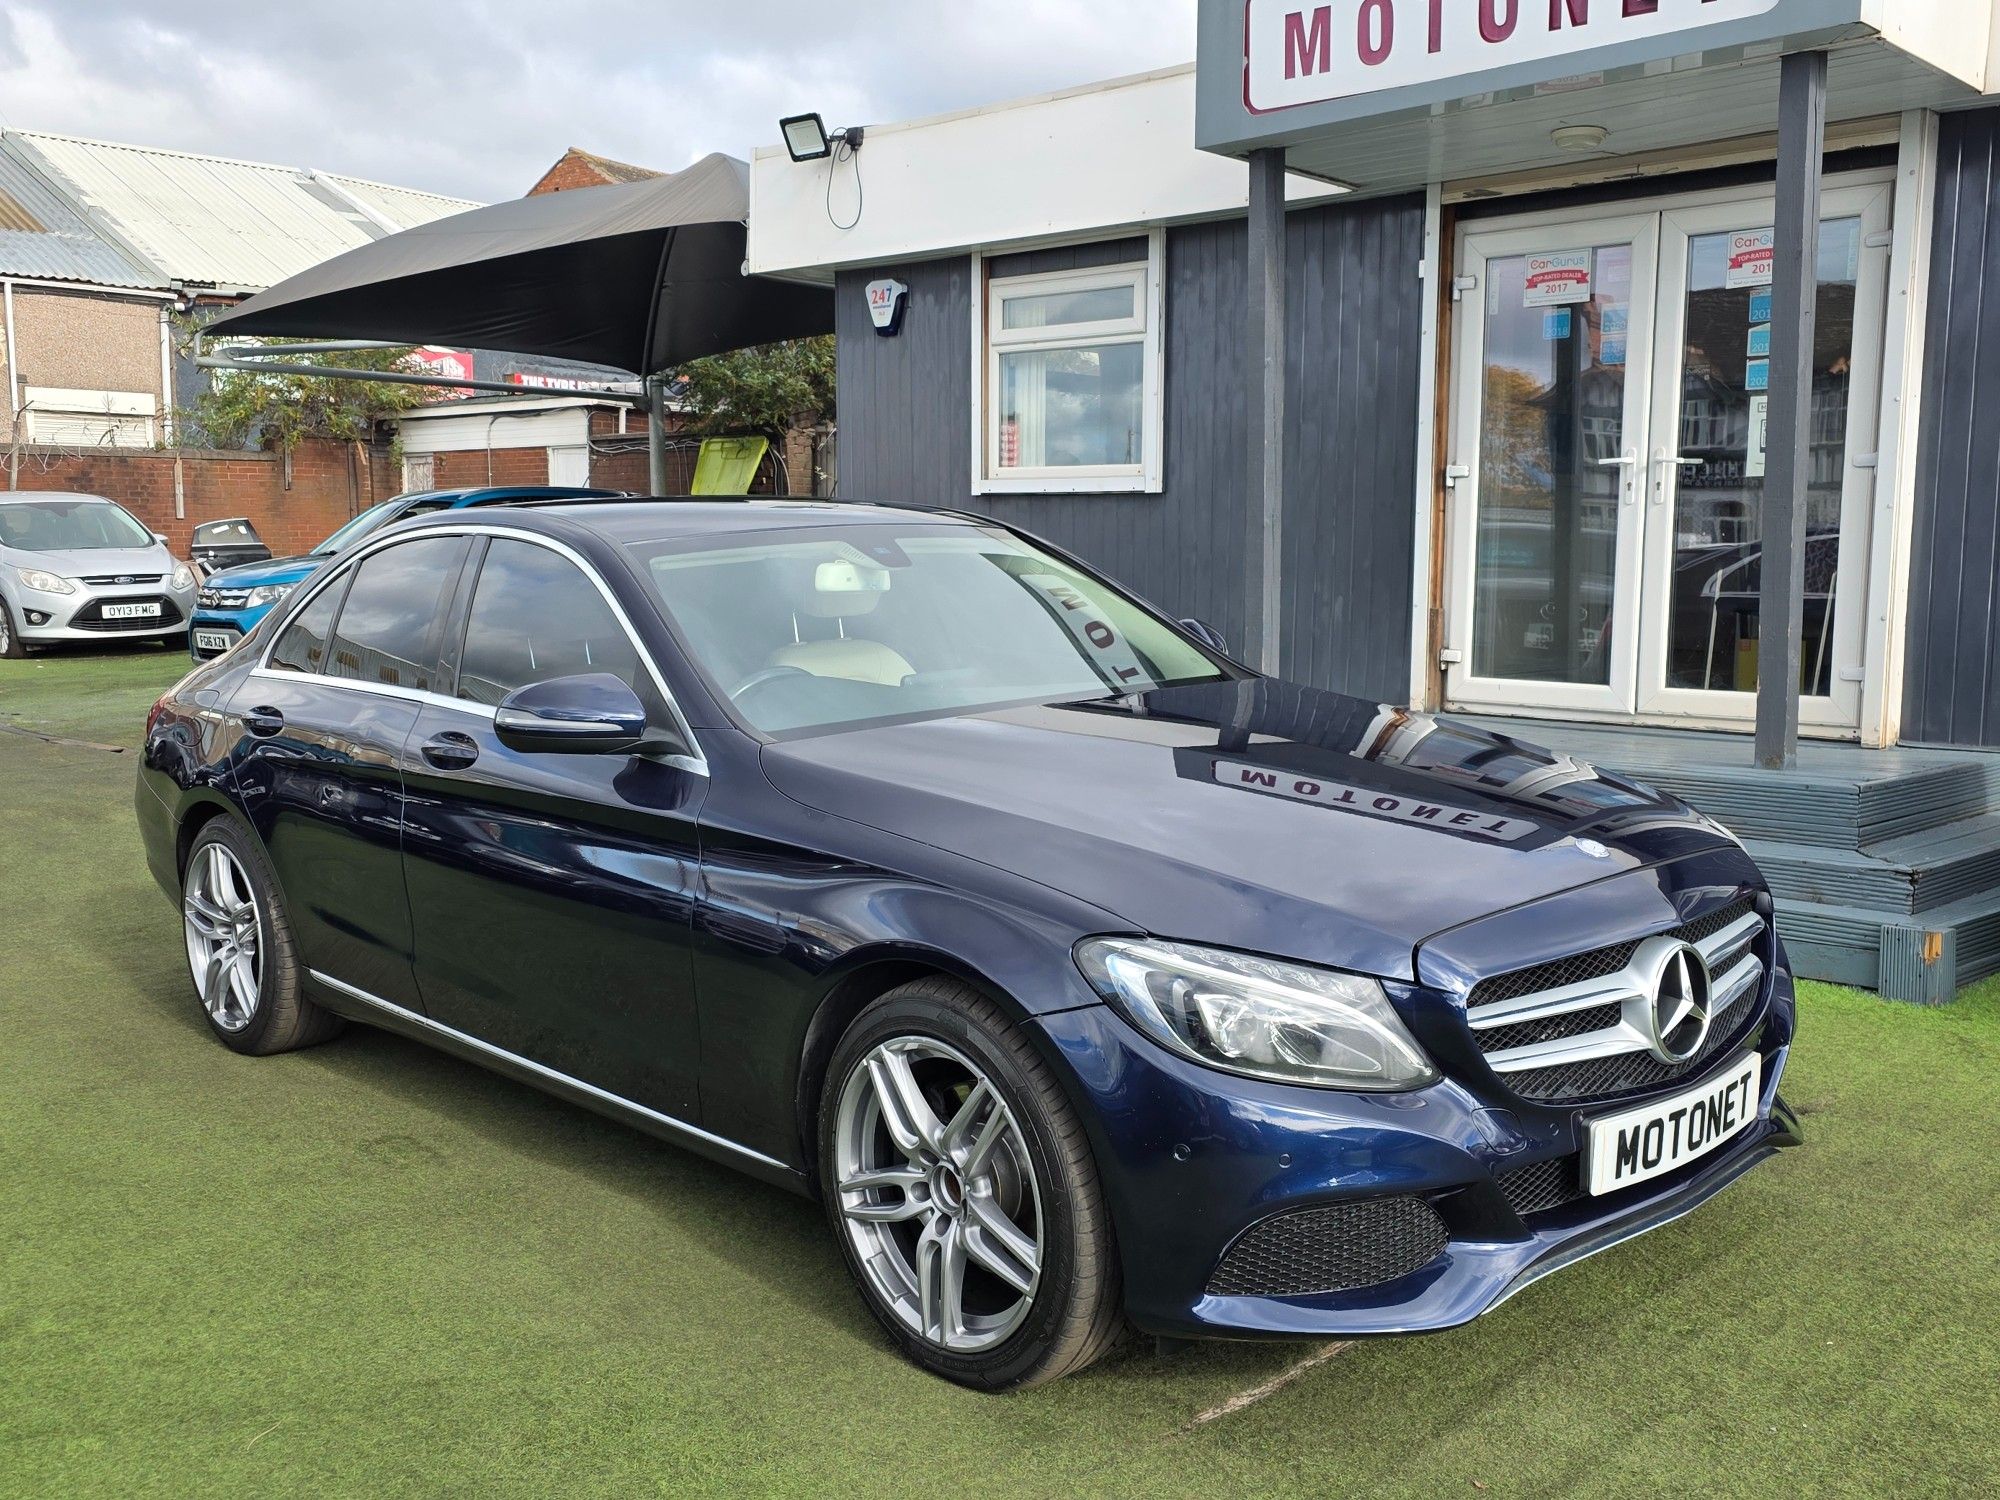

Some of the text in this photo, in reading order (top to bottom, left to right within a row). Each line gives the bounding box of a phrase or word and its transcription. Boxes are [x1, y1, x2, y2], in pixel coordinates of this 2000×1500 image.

[1284, 0, 1717, 80] MOTO
[1738, 251, 1771, 262] TOP-RATED
[1530, 256, 1585, 270] CarGurus
[1752, 263, 1771, 274] 201
[1533, 273, 1561, 282] TOP-RATED
[1545, 283, 1568, 294] 2017
[872, 285, 893, 304] 247
[1752, 309, 1771, 320] 201
[1752, 342, 1769, 353] 201
[1749, 377, 1768, 387] 202
[109, 605, 155, 616] OY13 FMG
[1615, 1070, 1752, 1180] MOTONET
